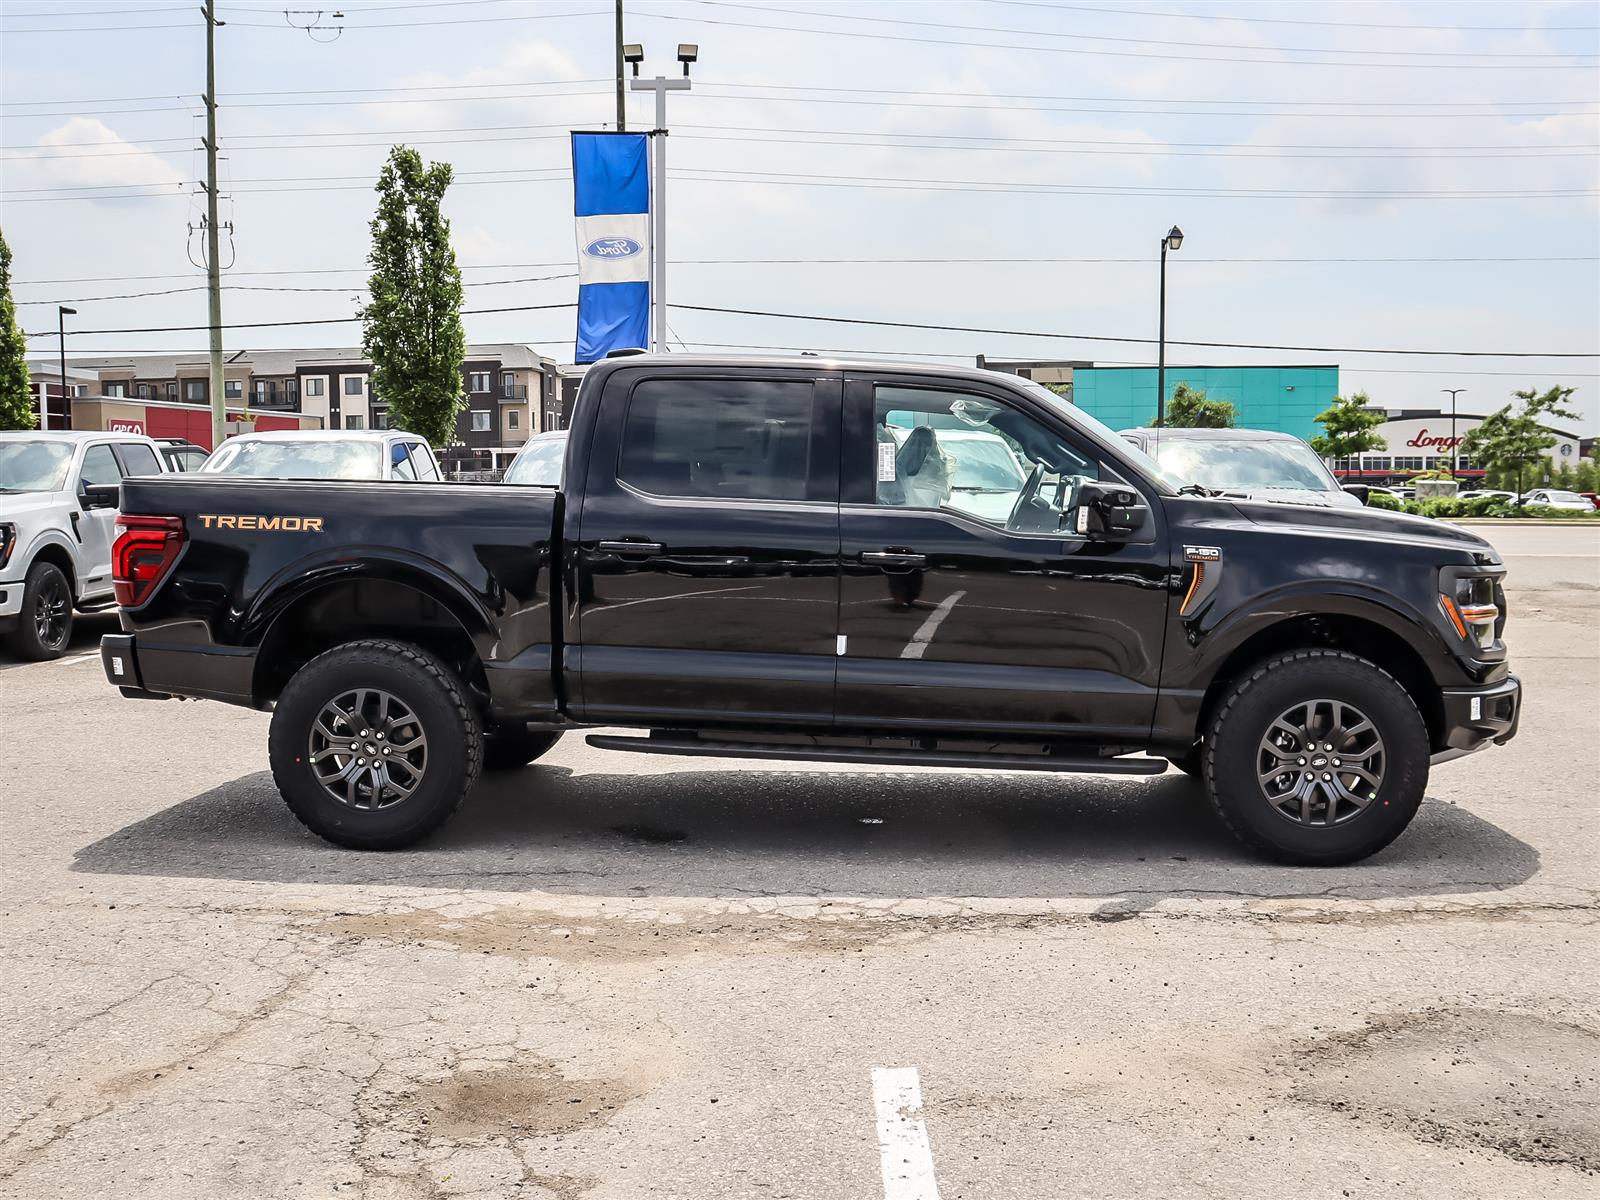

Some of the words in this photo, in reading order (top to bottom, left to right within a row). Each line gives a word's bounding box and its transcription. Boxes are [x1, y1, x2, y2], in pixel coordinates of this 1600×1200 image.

[1406, 428, 1472, 454] Longo
[199, 514, 323, 532] TREMOR
[1186, 547, 1219, 556] F-150
